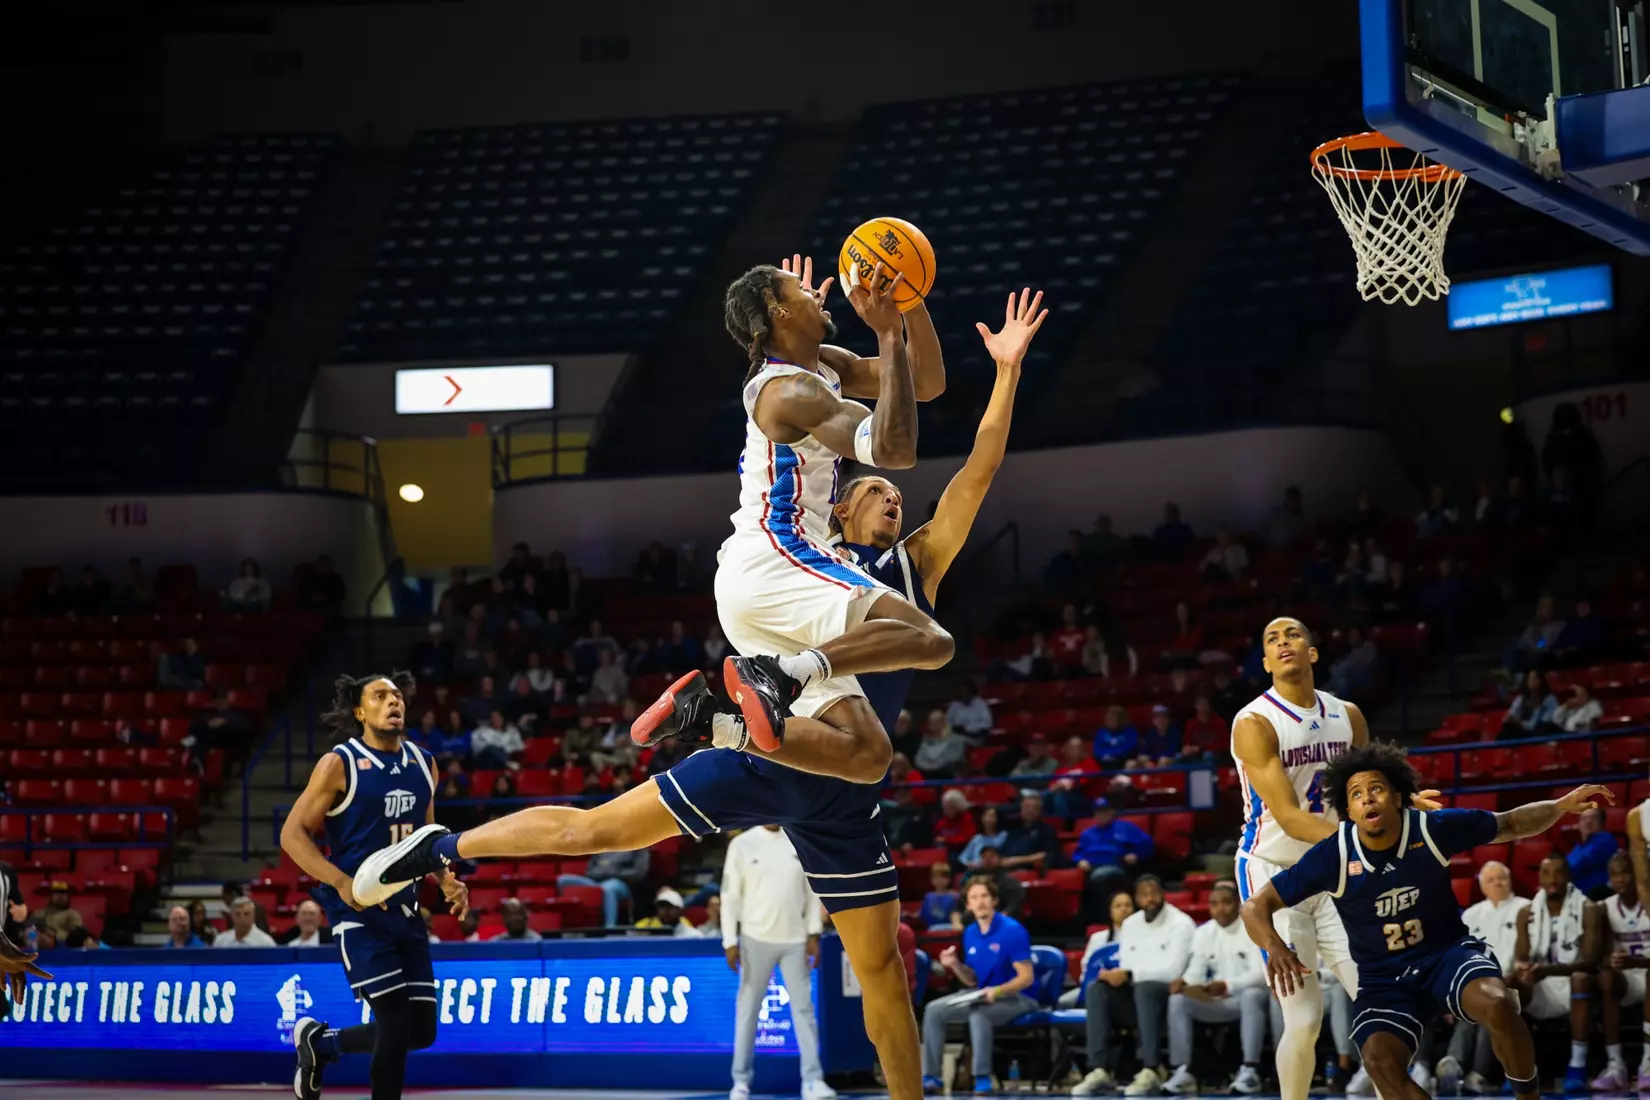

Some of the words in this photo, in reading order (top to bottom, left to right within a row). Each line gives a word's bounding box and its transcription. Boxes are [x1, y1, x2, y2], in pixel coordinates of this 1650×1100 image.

[1583, 393, 1627, 422] 101
[384, 788, 416, 819] UTEP
[1306, 770, 1326, 813] 4
[1374, 886, 1420, 917] UTEP
[1383, 918, 1425, 951] 23
[99, 981, 144, 1022] THE
[154, 980, 236, 1023] GLASS
[511, 977, 571, 1023] THE
[584, 976, 691, 1024] GLASS
